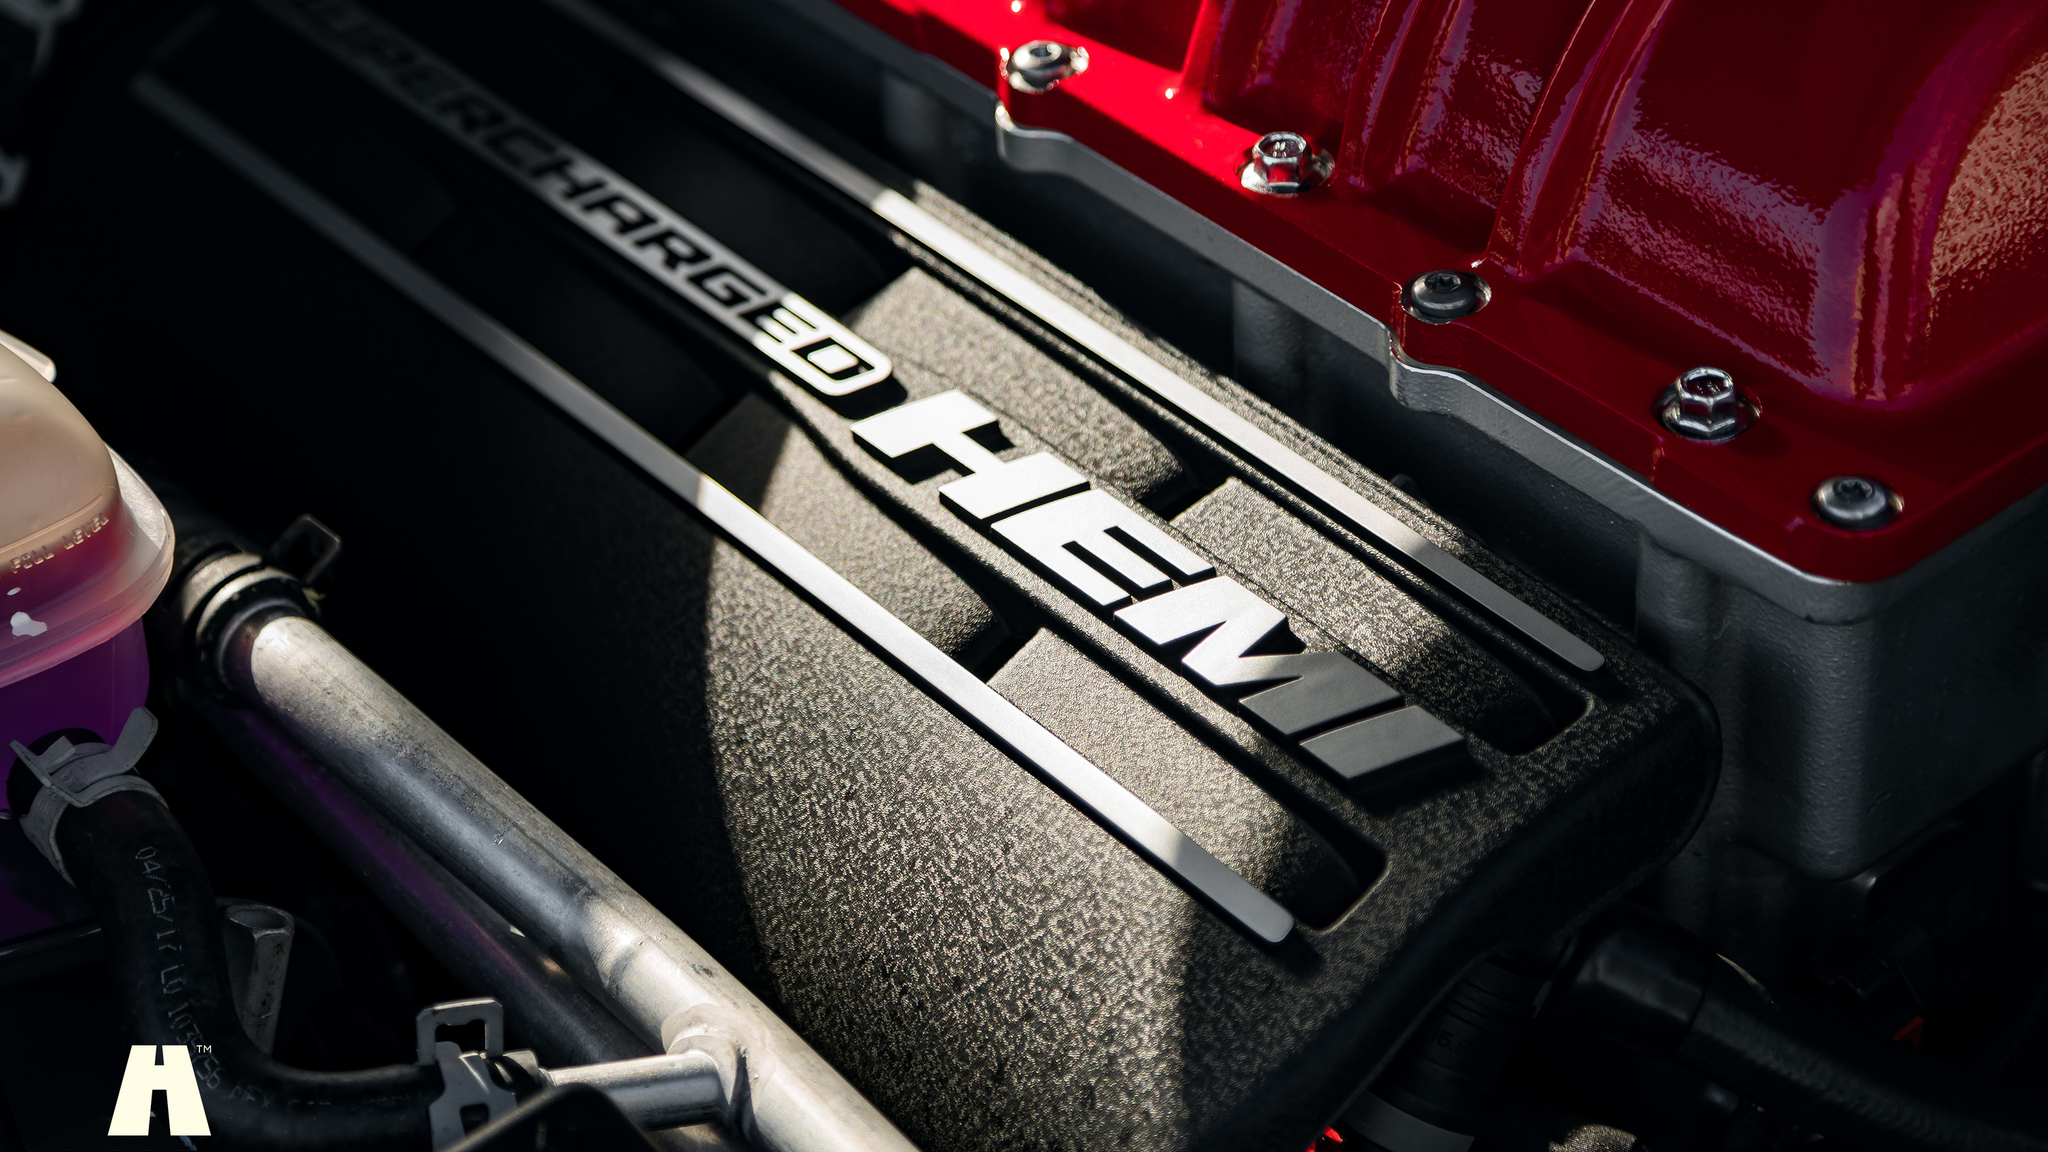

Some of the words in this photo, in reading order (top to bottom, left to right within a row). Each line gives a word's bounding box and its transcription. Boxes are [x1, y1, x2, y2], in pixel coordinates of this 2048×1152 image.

[284, 0, 874, 381] UPERCHARGED
[61, 511, 110, 550] LEVEL
[851, 389, 1467, 786] HEMI
